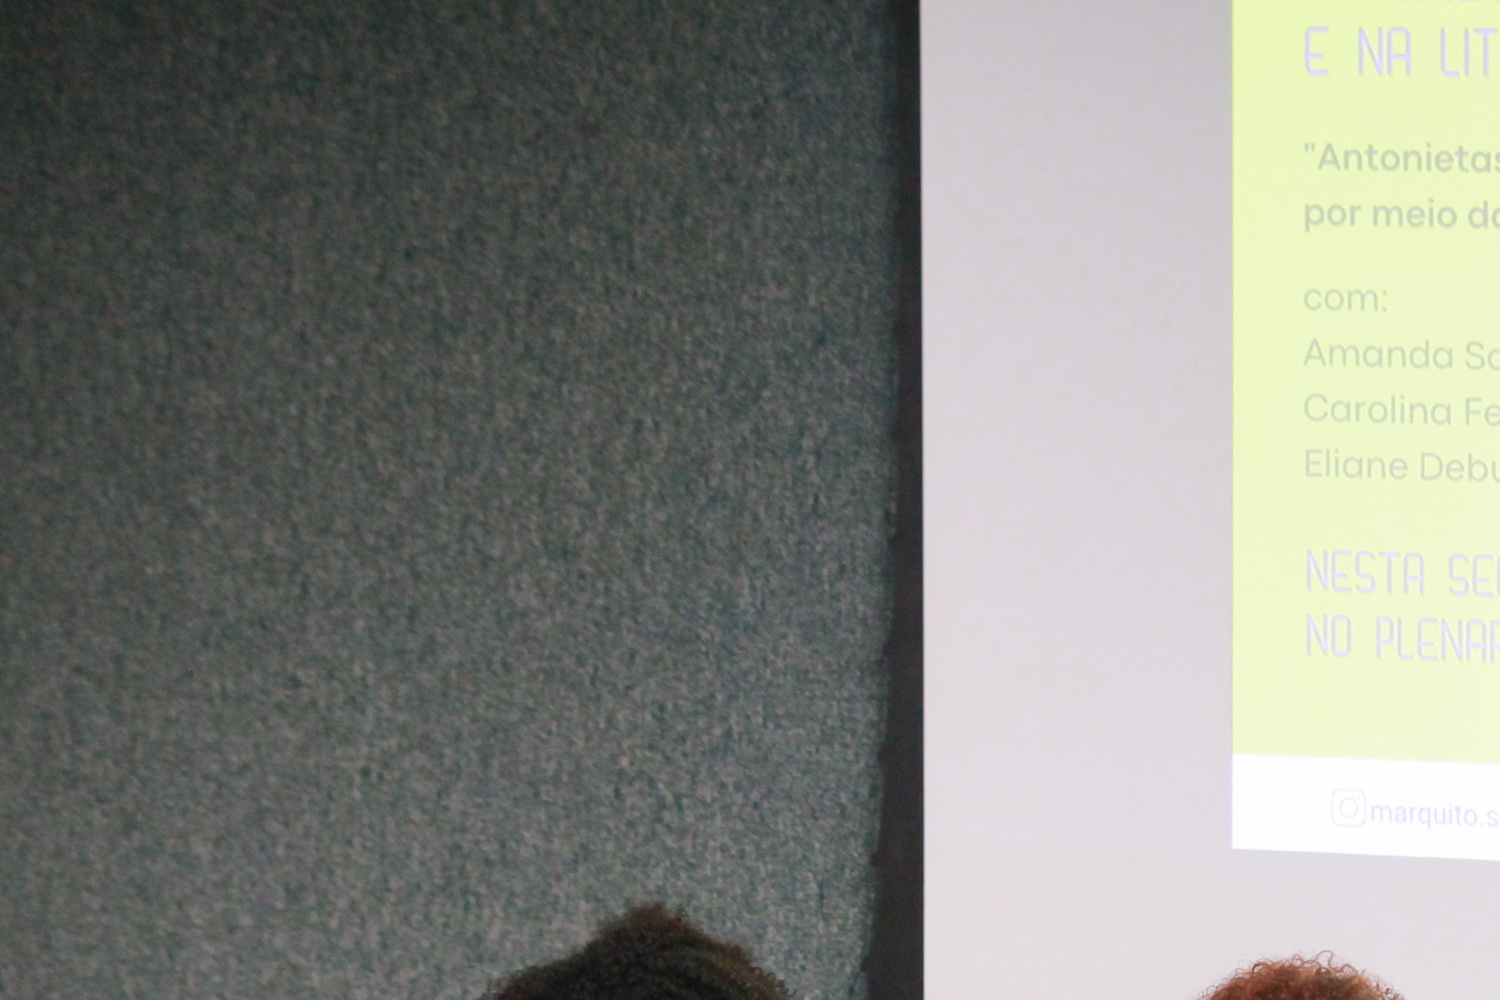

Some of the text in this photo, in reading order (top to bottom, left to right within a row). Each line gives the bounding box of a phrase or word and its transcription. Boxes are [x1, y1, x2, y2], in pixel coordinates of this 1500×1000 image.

[1304, 25, 1329, 76] E
[1357, 26, 1412, 76] NA
[1304, 204, 1362, 232] por
[1372, 198, 1458, 229] meio
[1303, 288, 1387, 312] com:
[1303, 337, 1453, 370] Amanda
[1303, 392, 1452, 426] Carolina
[1305, 448, 1409, 481] Eliane
[1306, 549, 1425, 596] NESTA
[1306, 613, 1353, 658] NO
